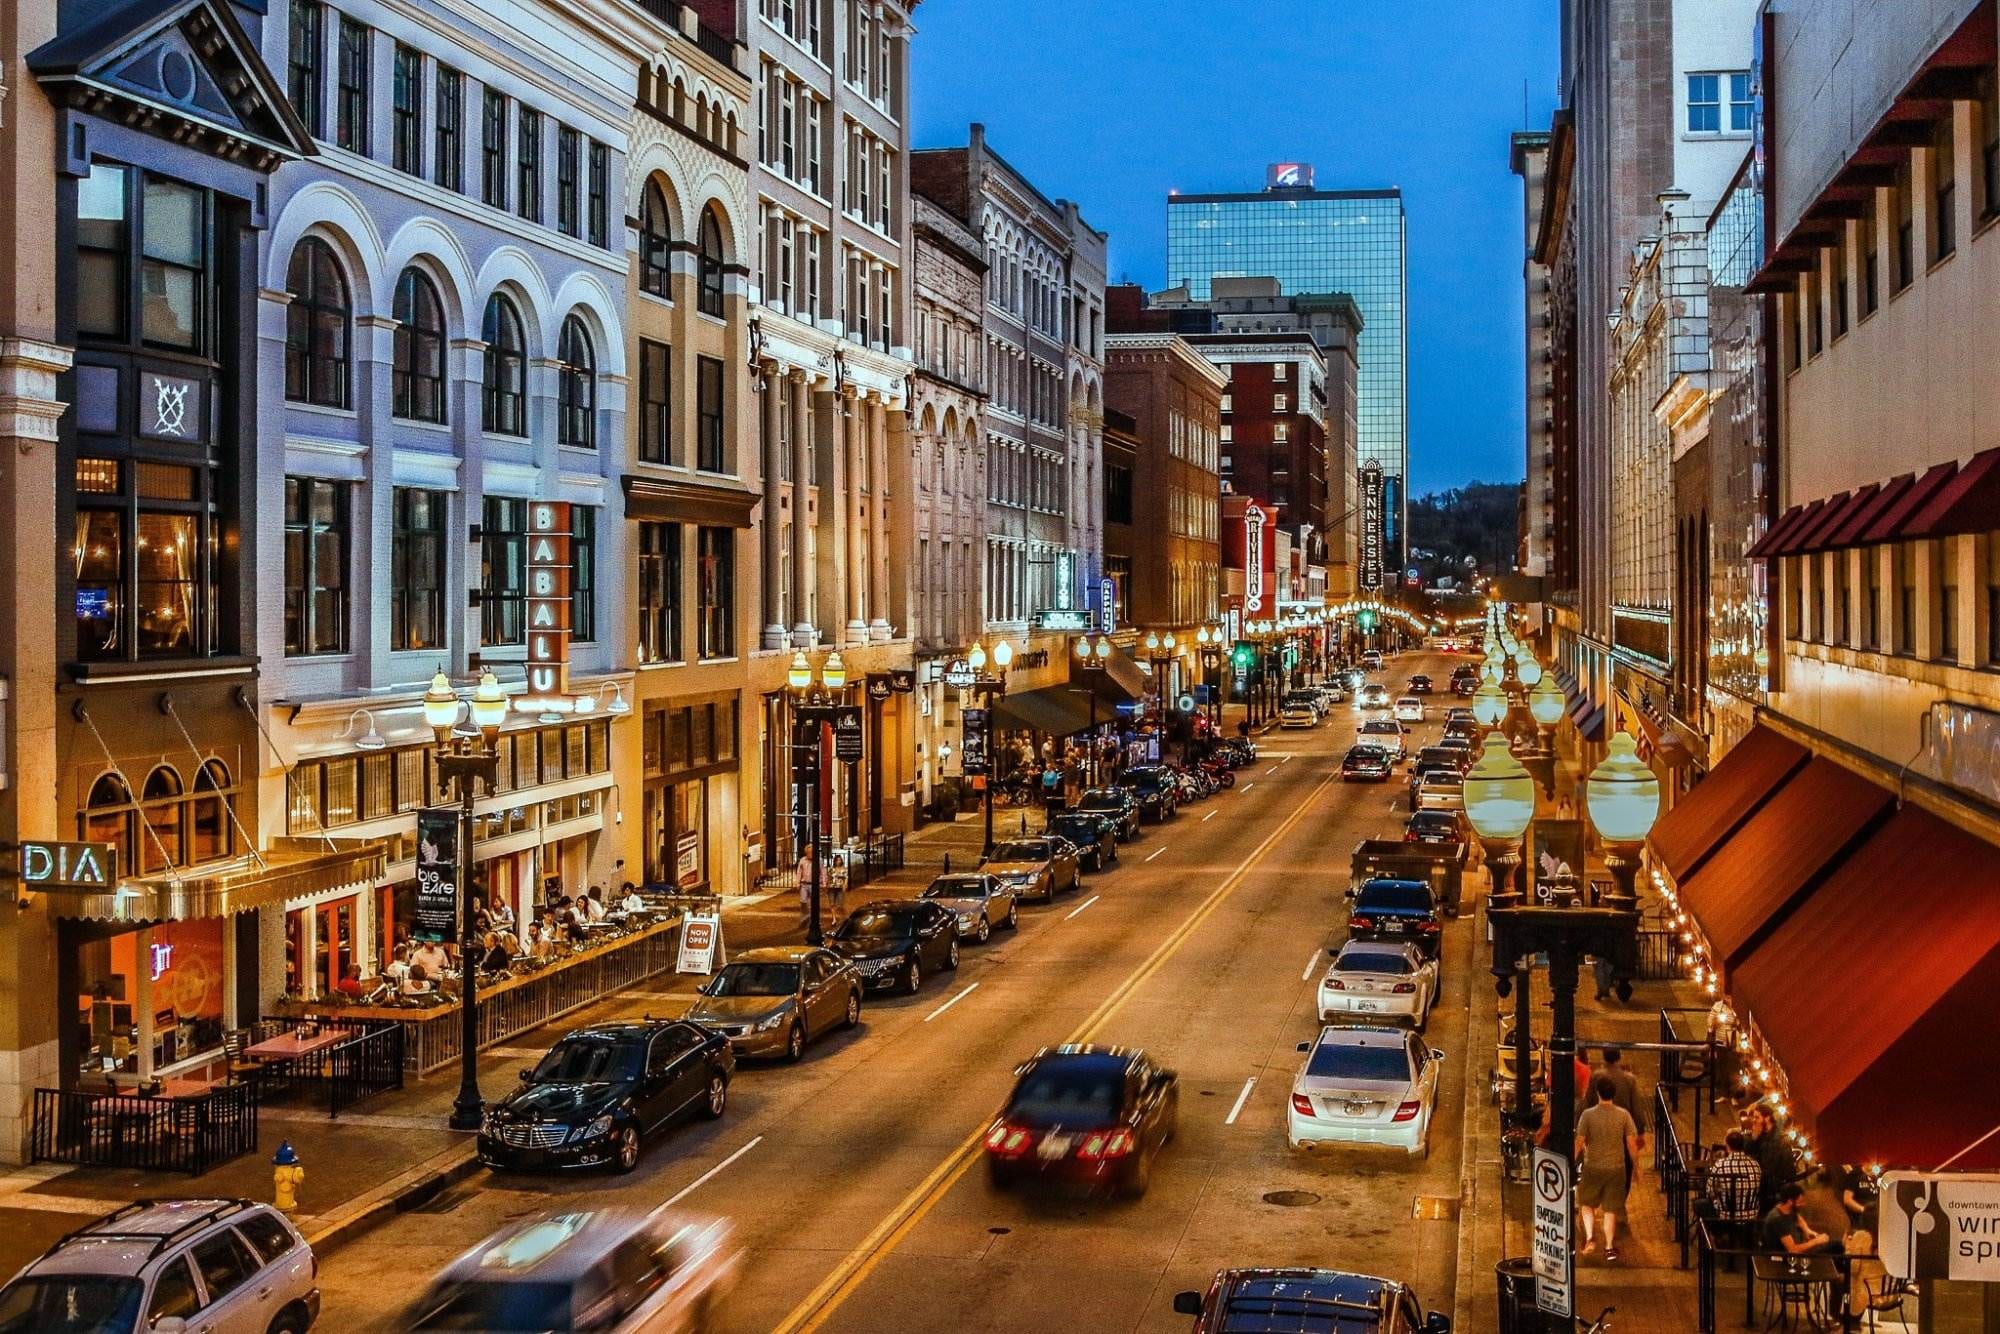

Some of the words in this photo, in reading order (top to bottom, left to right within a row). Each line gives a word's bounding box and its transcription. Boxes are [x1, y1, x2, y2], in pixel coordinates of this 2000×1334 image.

[1366, 472, 1377, 584] TENNESSEE
[1250, 522, 1258, 596] RIVIERA
[534, 507, 553, 690] BABALU
[24, 845, 104, 882] DIA
[1948, 1200, 1999, 1209] downtown
[1536, 1239, 1564, 1260] PARKING
[1543, 1225, 1557, 1242] NO
